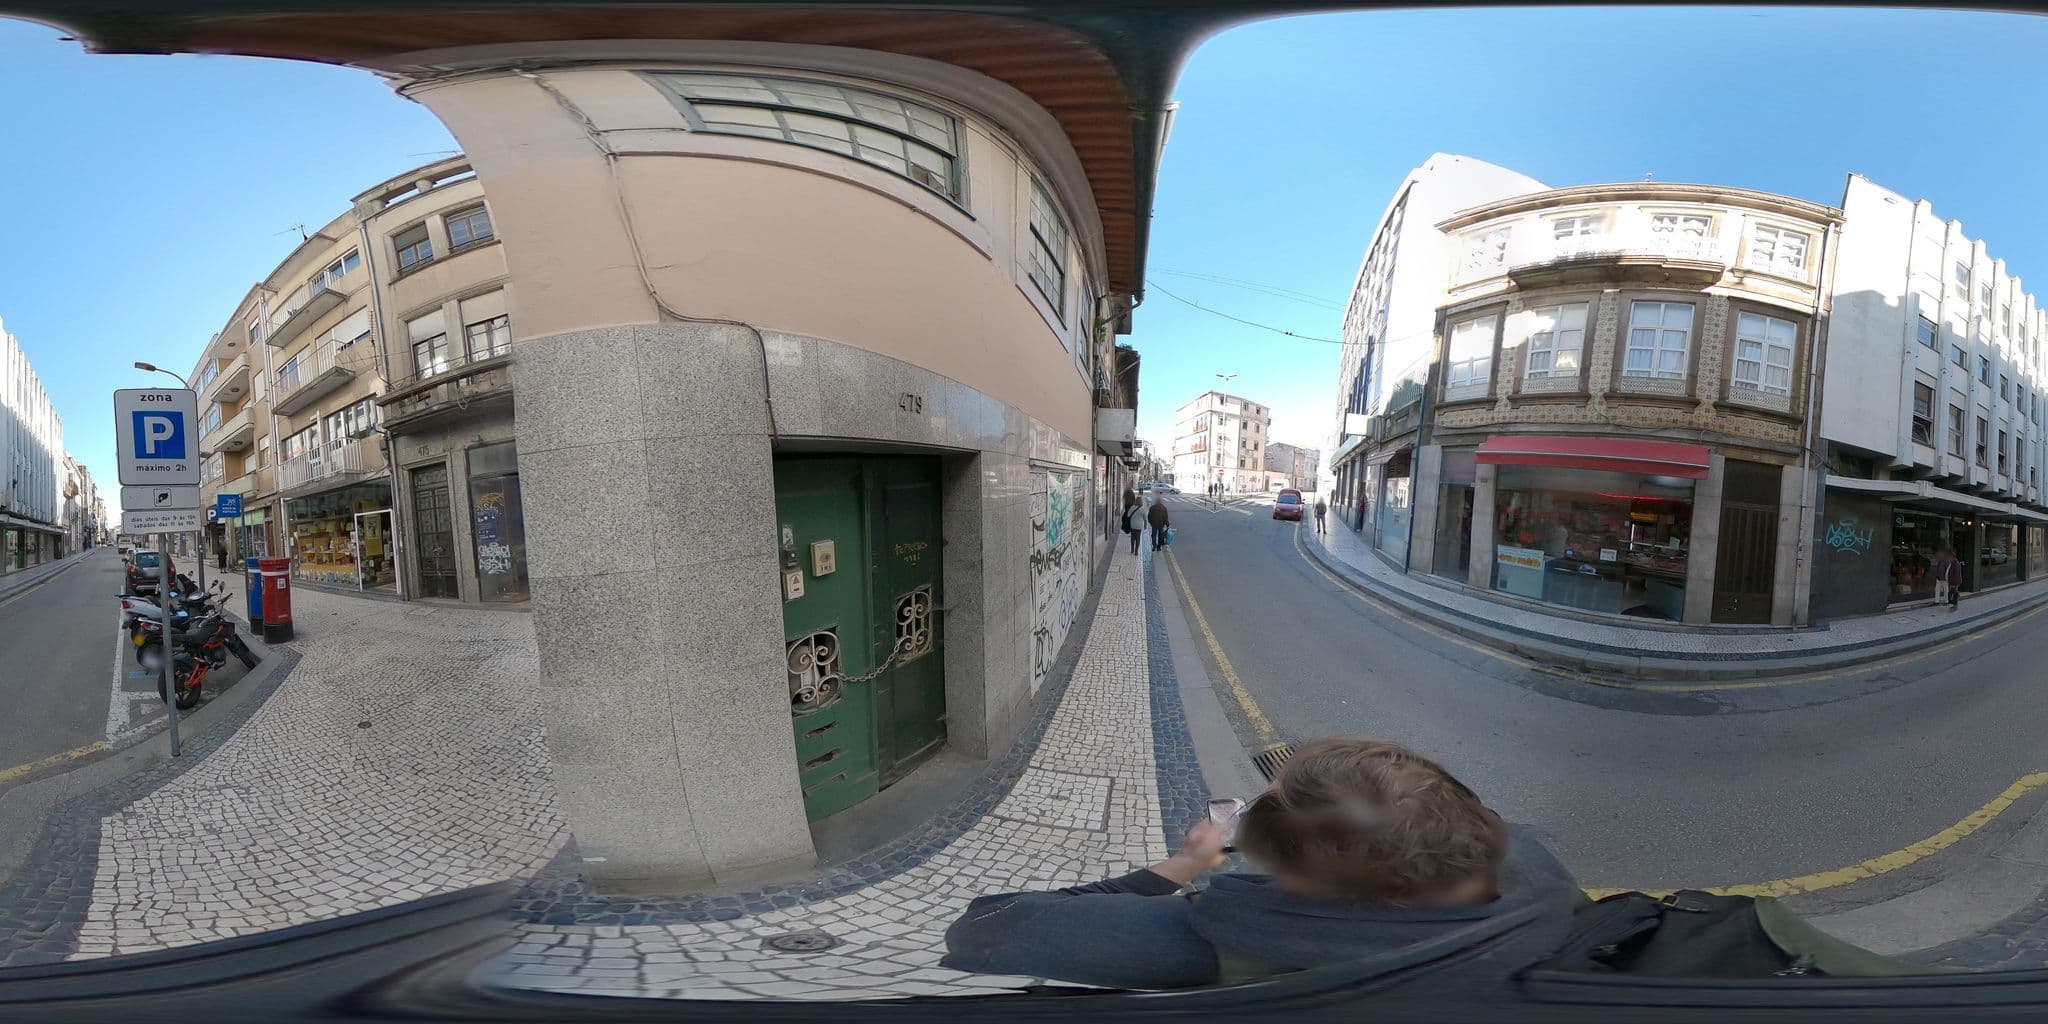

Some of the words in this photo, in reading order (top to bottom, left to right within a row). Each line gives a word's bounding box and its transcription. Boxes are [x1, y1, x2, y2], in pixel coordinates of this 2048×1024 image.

[140, 393, 173, 402] zona
[899, 392, 922, 414] 479
[143, 416, 175, 454] P
[136, 463, 171, 472] máximo
[176, 464, 187, 472] 2h
[207, 509, 217, 520] P
